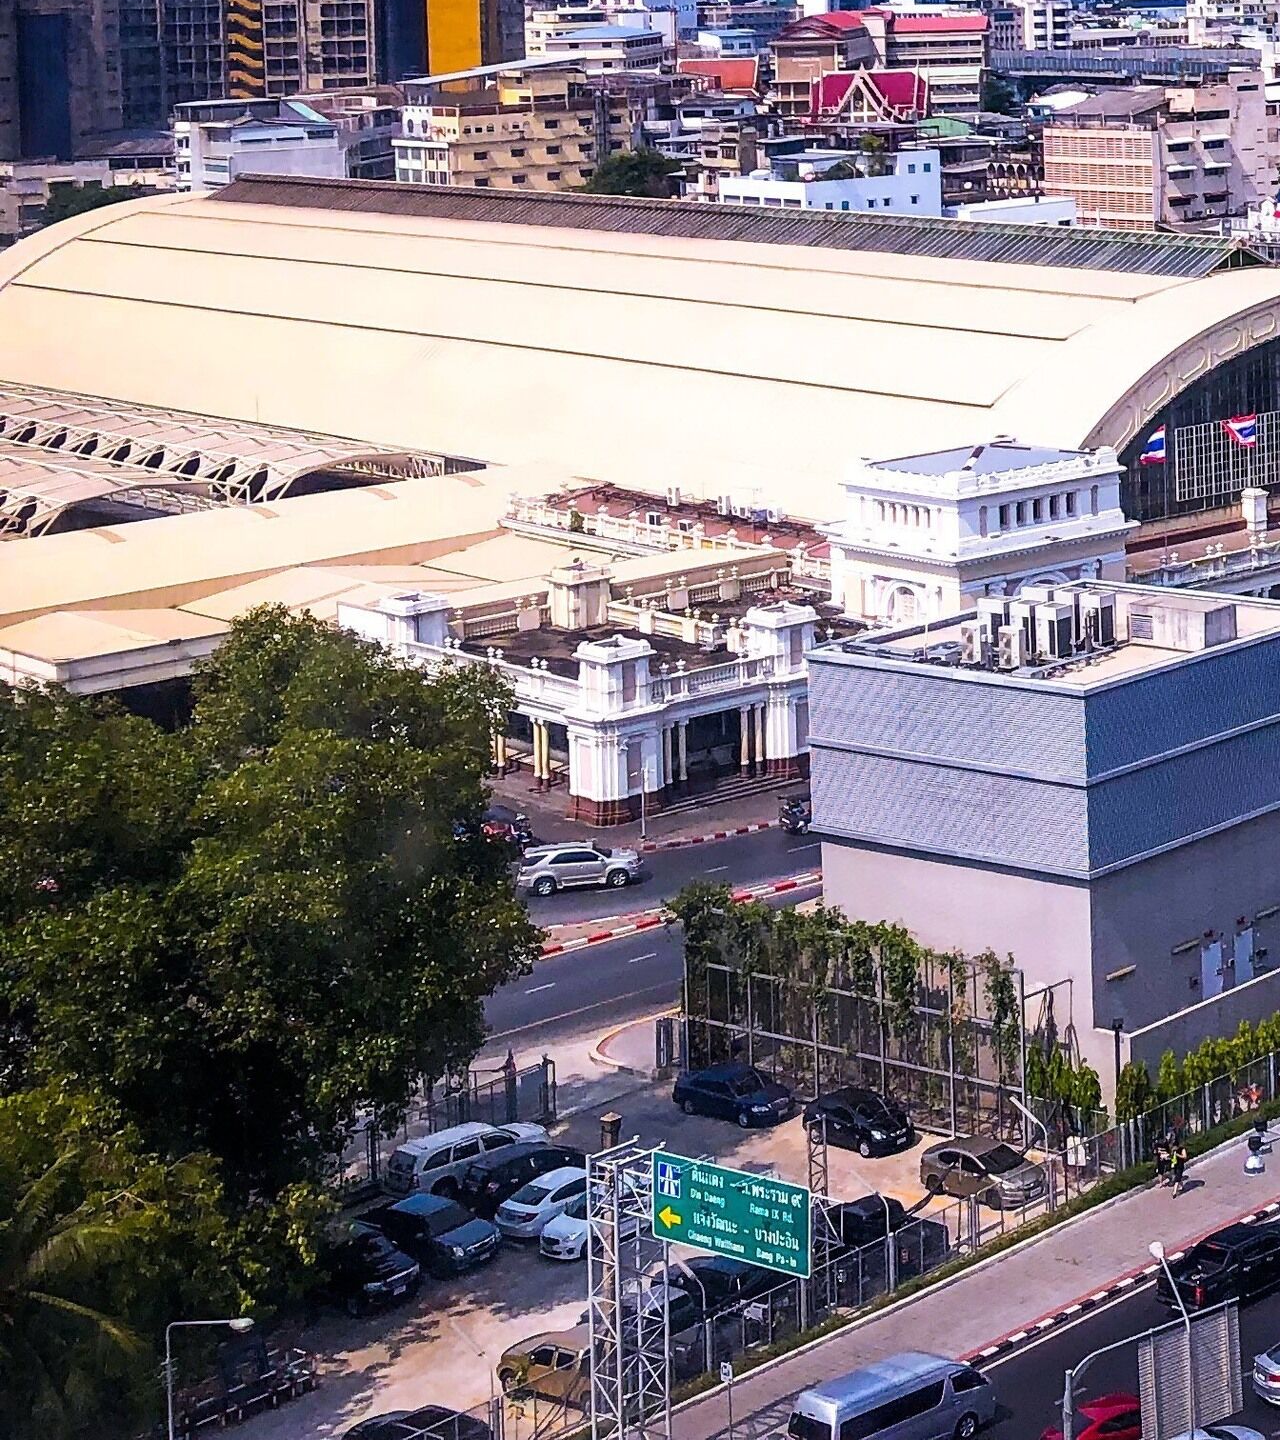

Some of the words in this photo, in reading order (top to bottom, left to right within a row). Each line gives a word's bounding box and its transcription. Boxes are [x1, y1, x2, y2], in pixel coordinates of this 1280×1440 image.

[690, 1188, 701, 1200] Din
[704, 1191, 726, 1209] Daeng
[749, 1203, 769, 1217] Rama
[693, 1210, 738, 1234] แจ้งวัฒนะ
[755, 1227, 800, 1251] บางปะอิน
[756, 1247, 773, 1264] Bang
